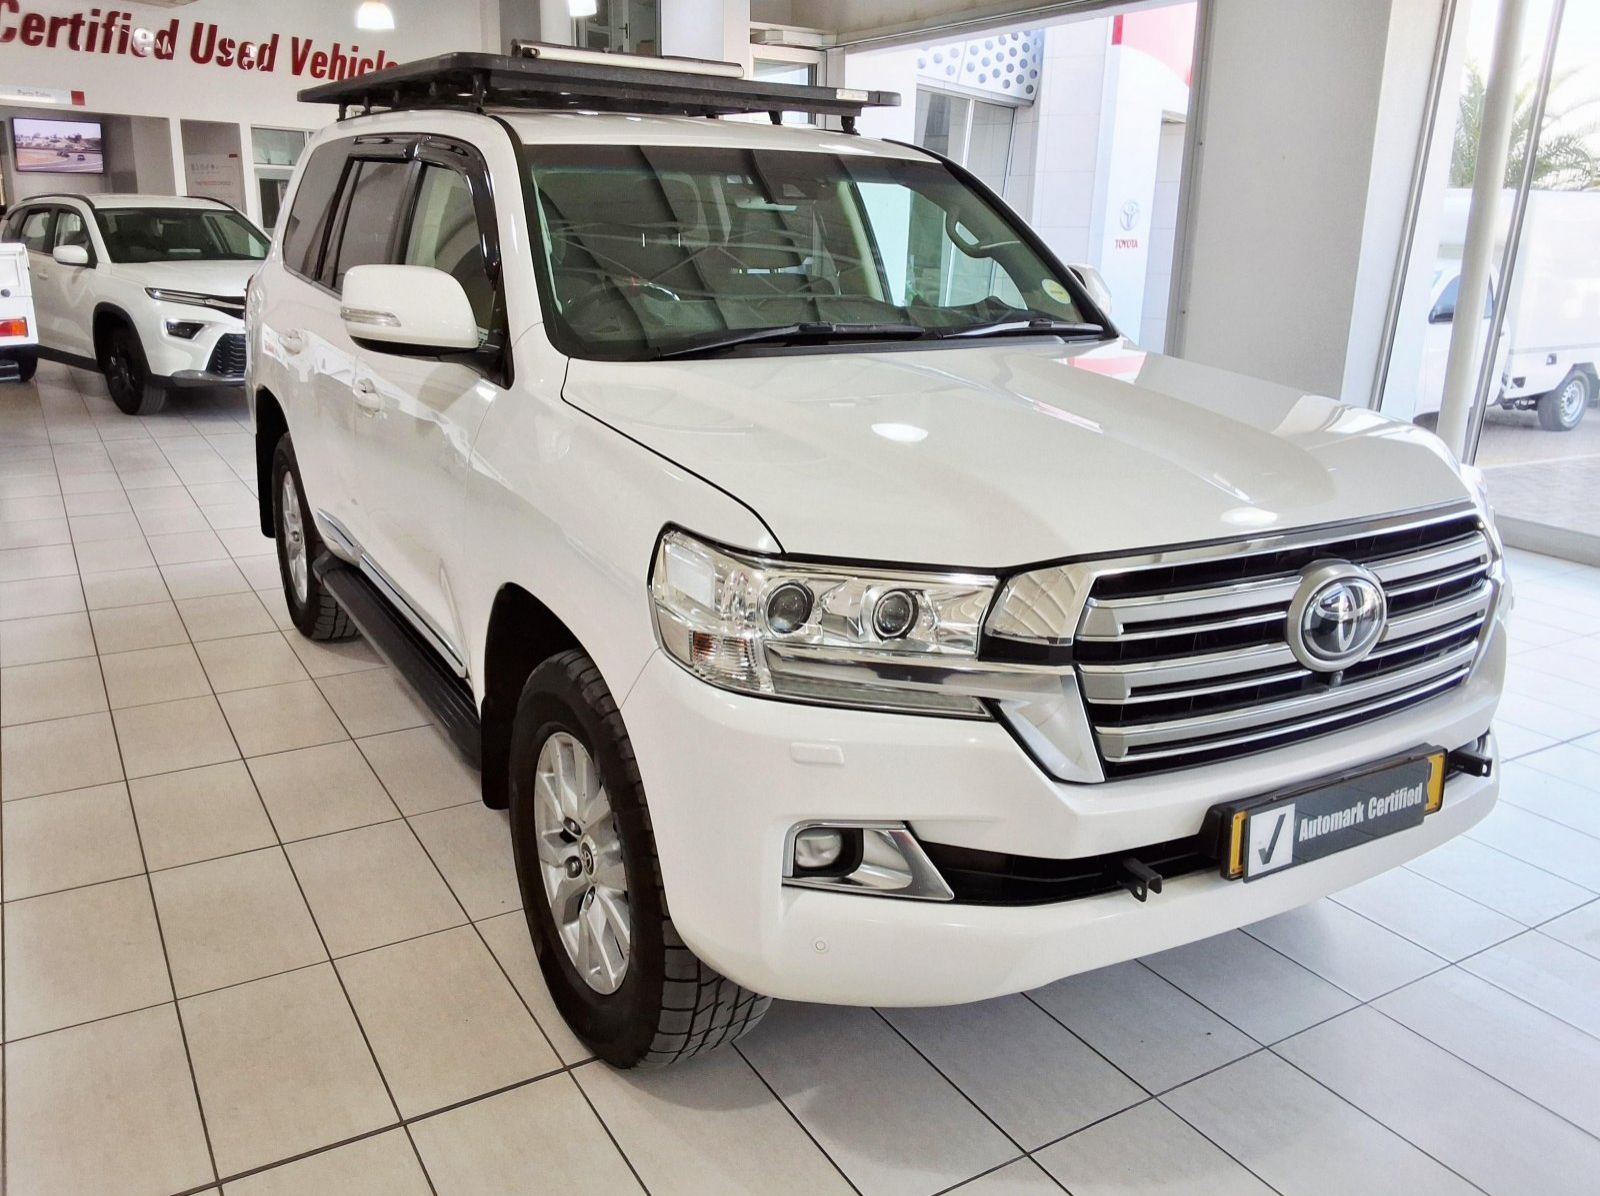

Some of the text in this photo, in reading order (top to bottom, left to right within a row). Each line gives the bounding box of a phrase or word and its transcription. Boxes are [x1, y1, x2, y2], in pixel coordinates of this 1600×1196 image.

[0, 0, 400, 81] Certified Used Vehicl
[1115, 239, 1138, 248] TOYOTA
[1298, 782, 1423, 842] Automark Certified
